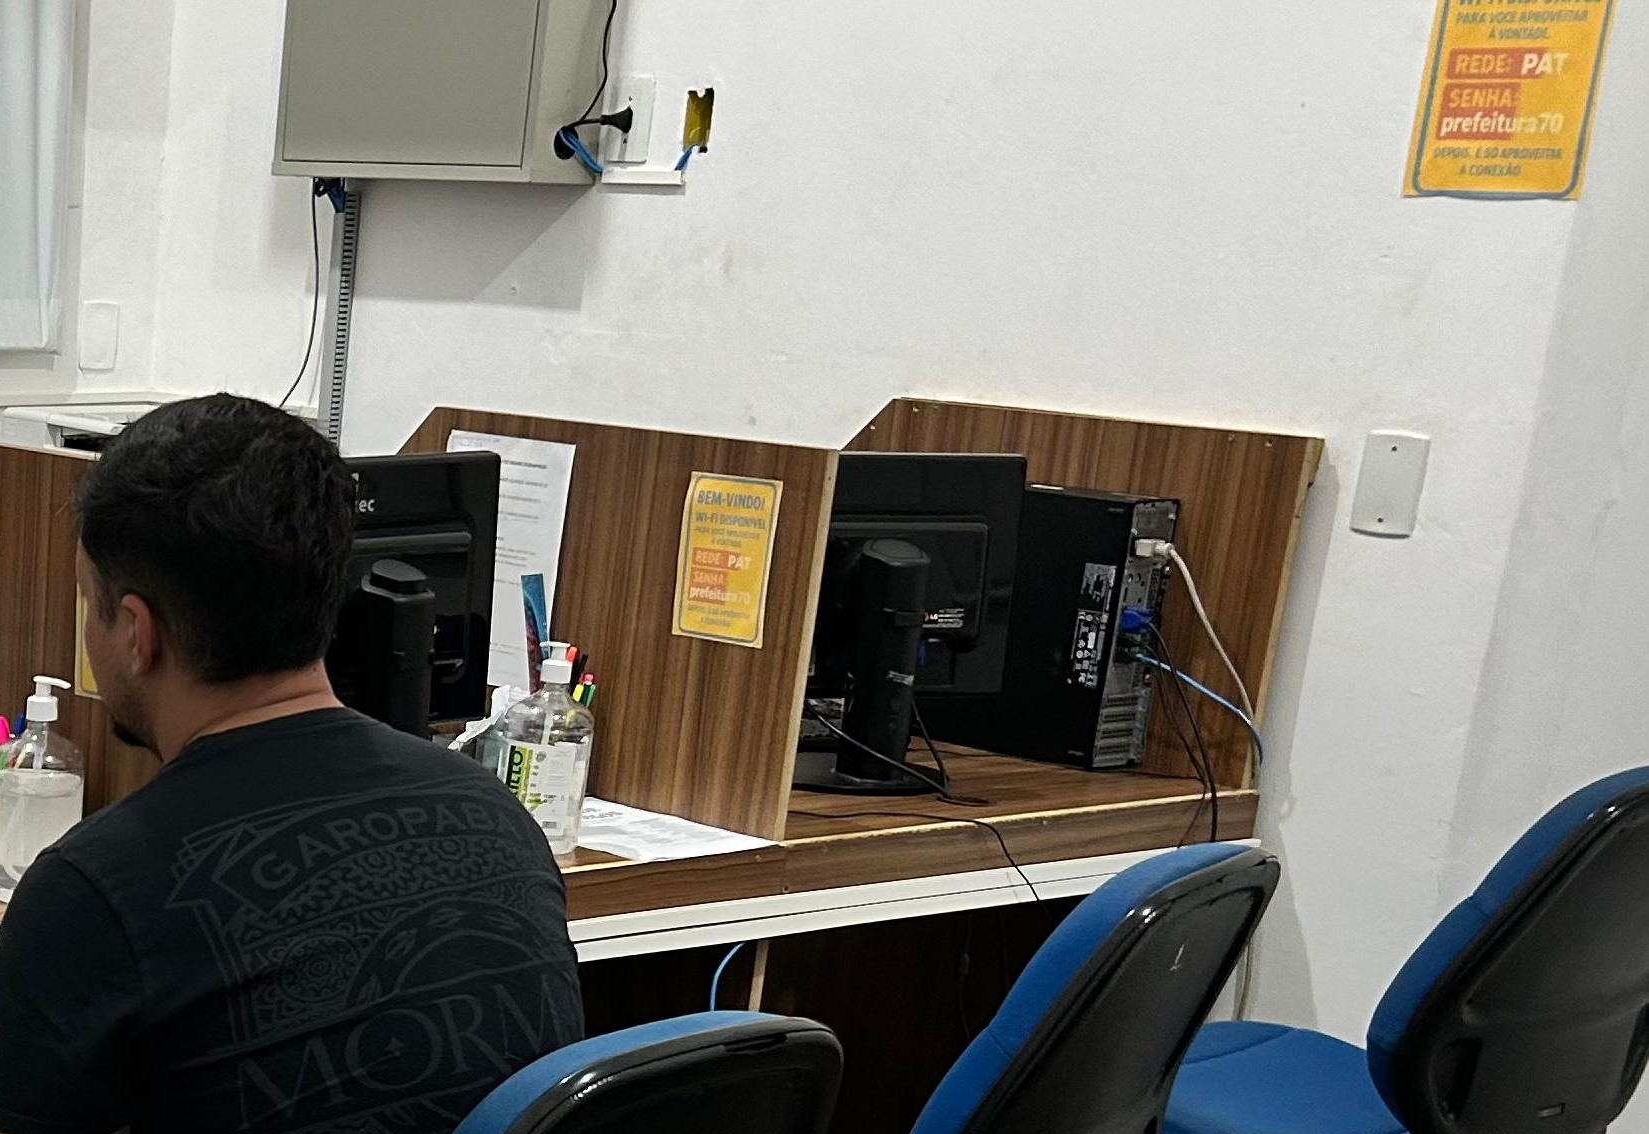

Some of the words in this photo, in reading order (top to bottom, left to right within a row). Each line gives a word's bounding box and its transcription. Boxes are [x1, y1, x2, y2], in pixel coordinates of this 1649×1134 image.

[1521, 53, 1569, 76] PAT
[1440, 111, 1565, 137] prefeitura70
[697, 490, 766, 511] BEM-VINDO!
[727, 554, 752, 570] PAT
